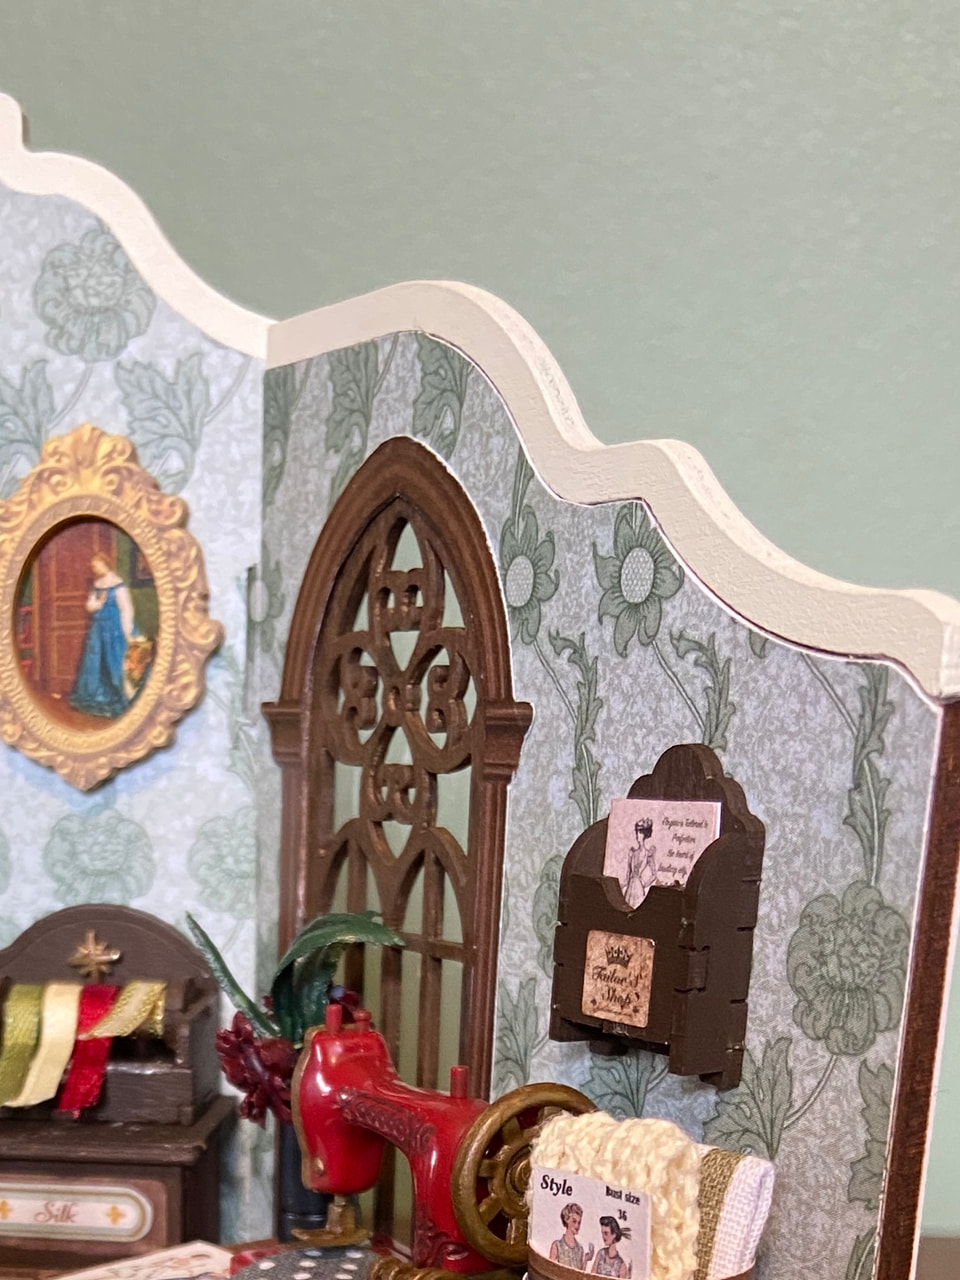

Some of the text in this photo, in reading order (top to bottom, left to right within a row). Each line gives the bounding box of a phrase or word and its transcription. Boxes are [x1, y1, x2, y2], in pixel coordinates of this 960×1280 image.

[540, 1174, 573, 1197] Style
[605, 1185, 640, 1206] Bust size
[33, 1200, 79, 1224] Silk
